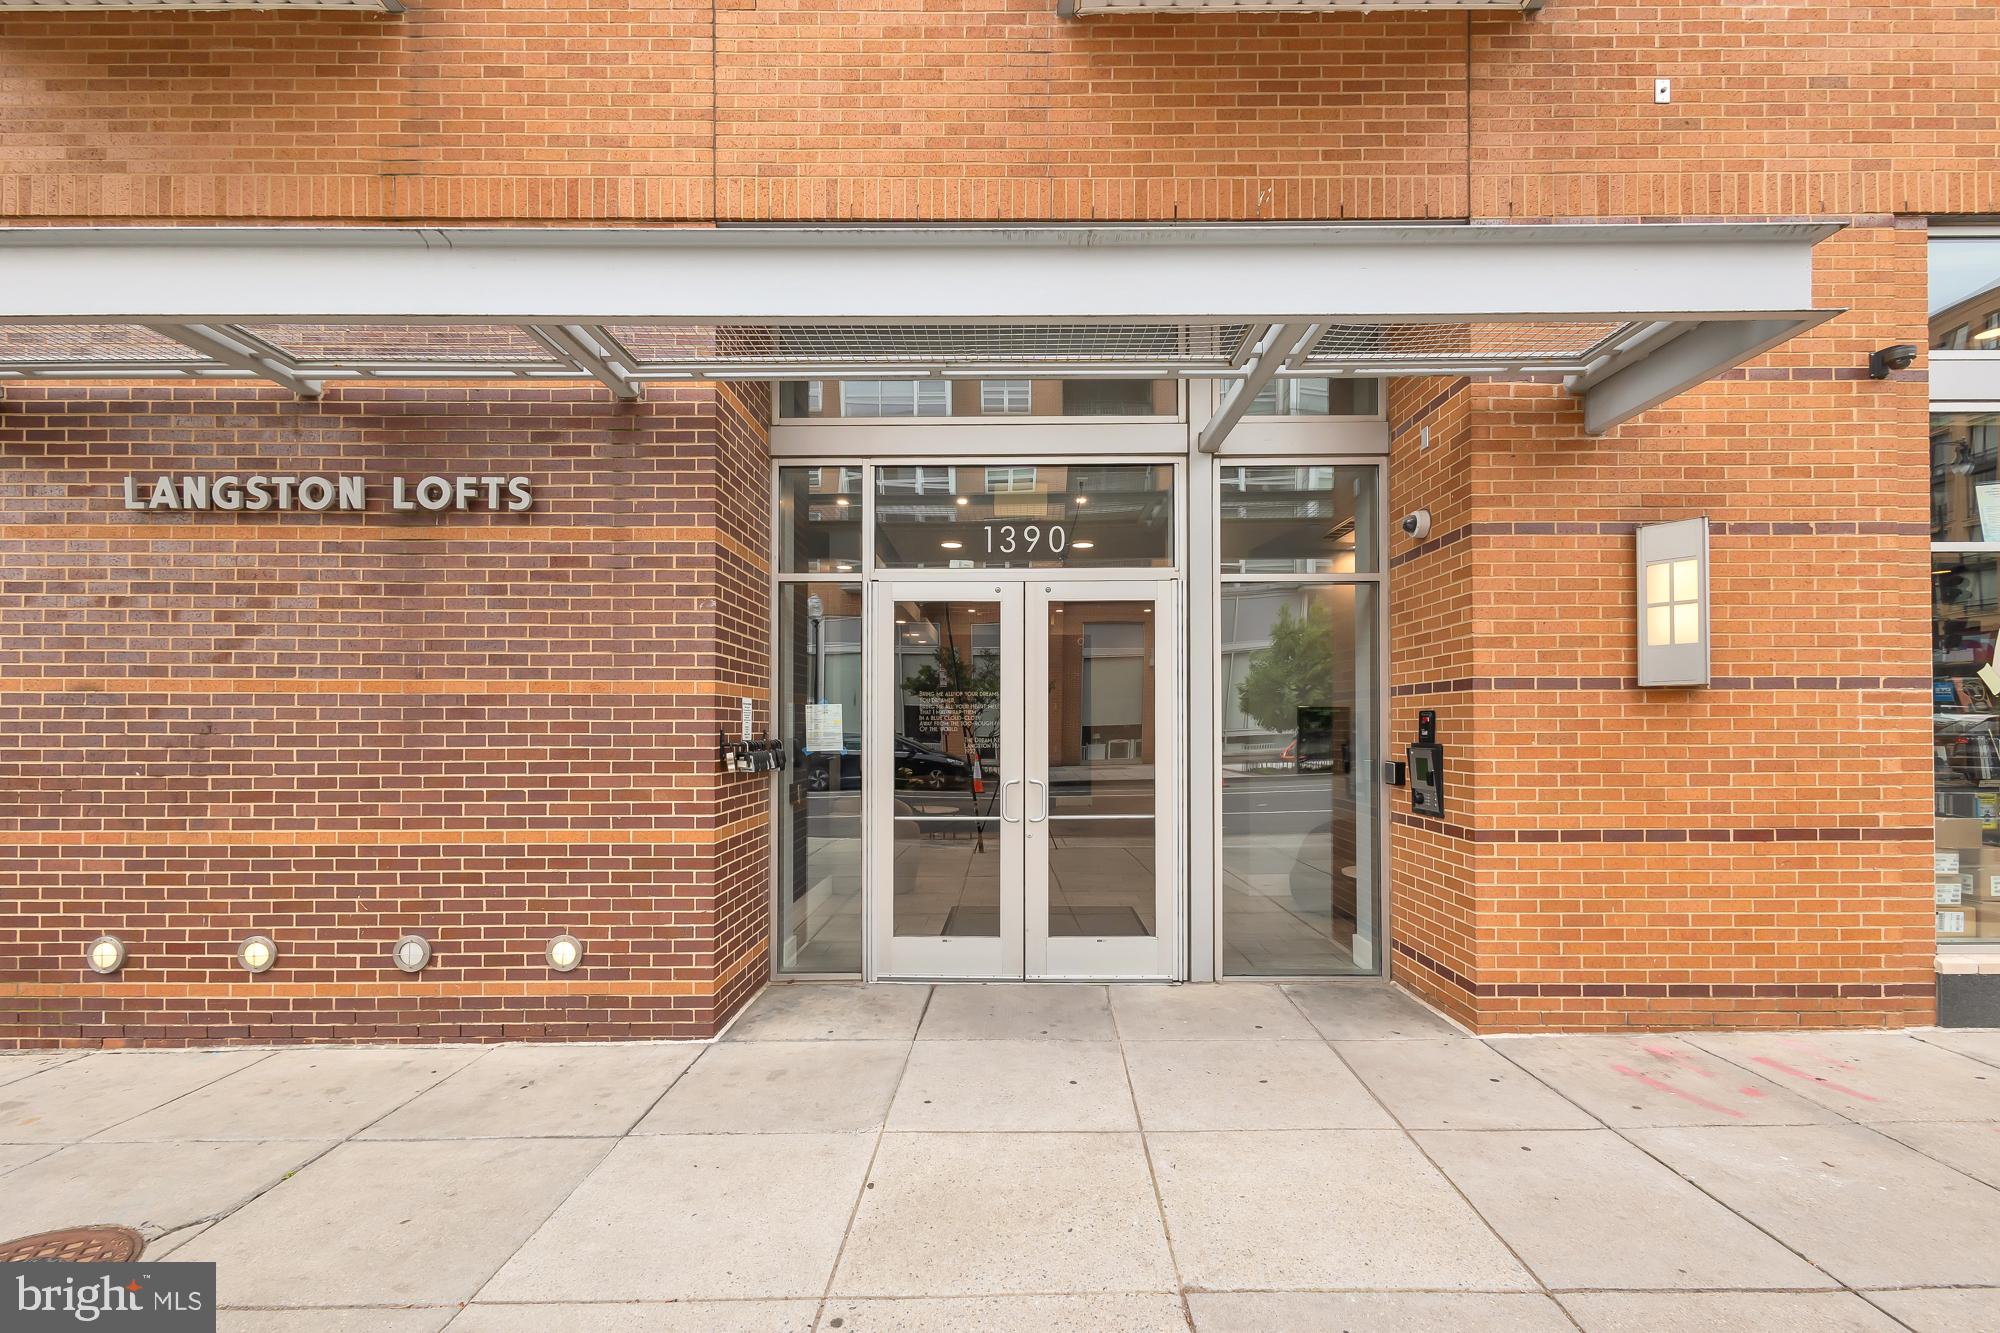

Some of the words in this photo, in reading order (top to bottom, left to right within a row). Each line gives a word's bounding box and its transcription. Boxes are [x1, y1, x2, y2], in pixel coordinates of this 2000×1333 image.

[123, 475, 367, 512] LANGSTON
[393, 475, 533, 512] LOFTS
[984, 525, 1066, 553] 1390
